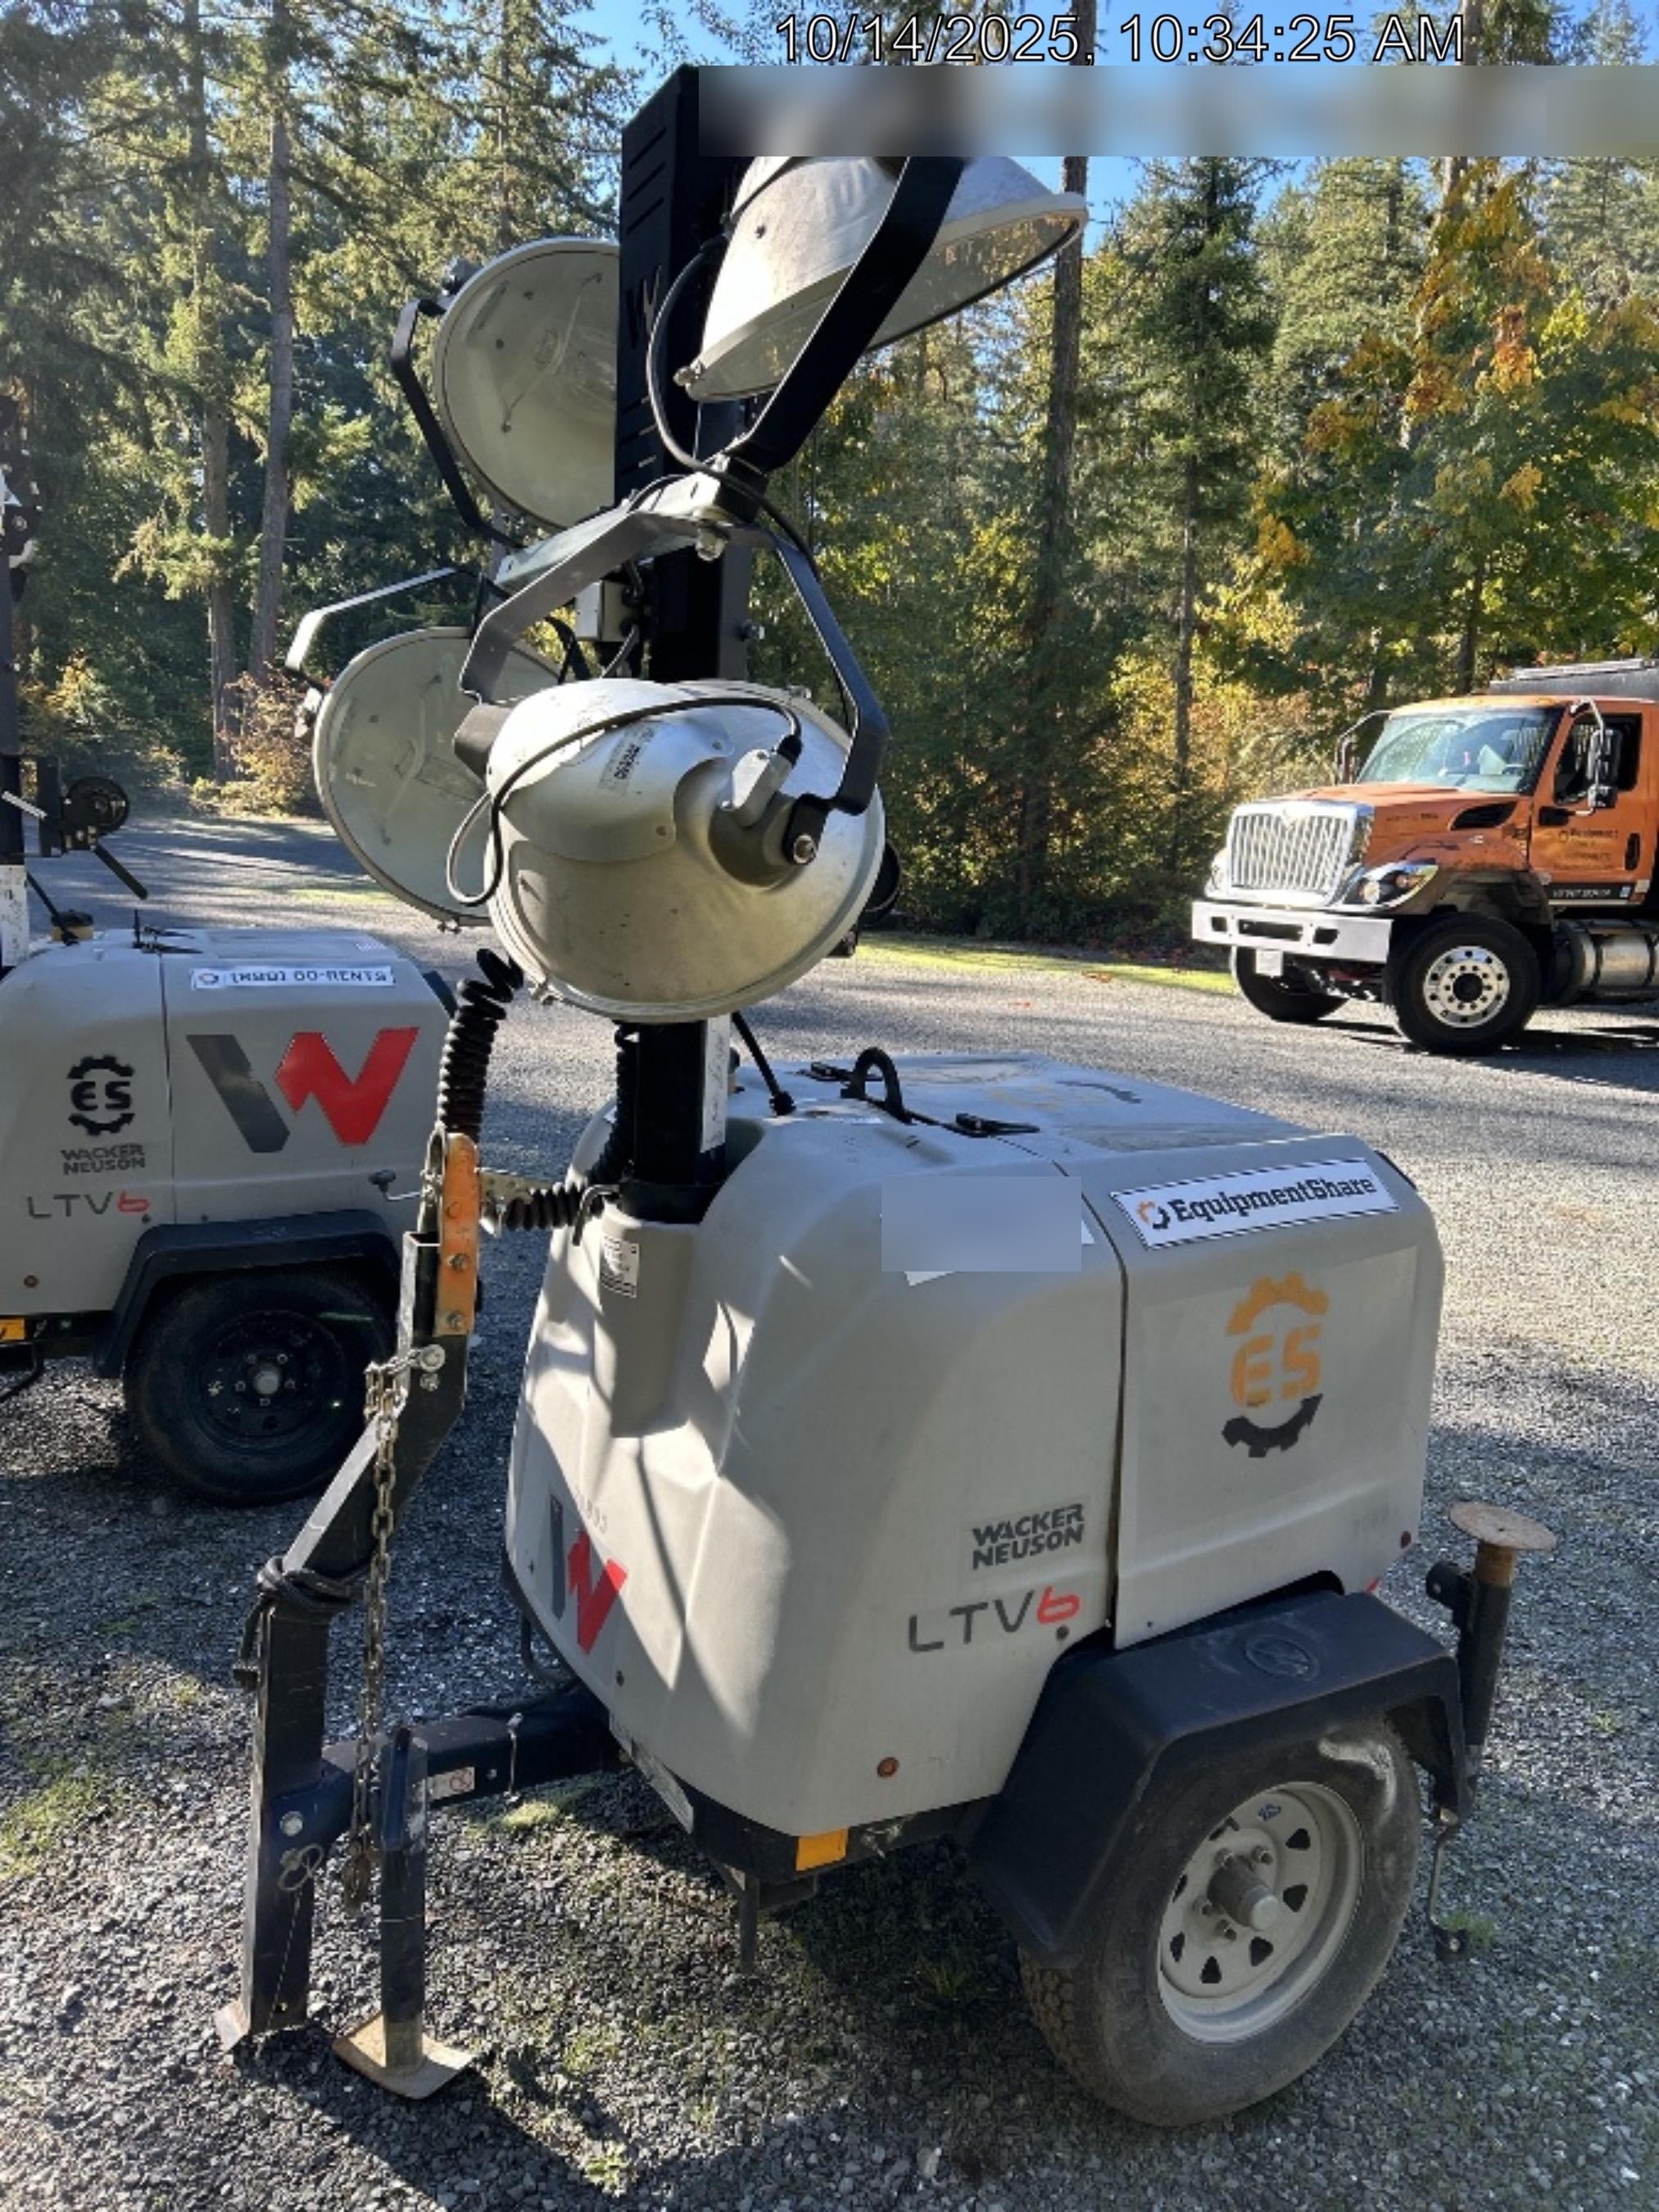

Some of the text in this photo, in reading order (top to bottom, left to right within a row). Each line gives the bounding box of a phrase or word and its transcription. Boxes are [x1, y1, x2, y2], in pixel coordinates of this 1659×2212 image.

[70, 1081, 133, 1112] ES
[61, 1143, 145, 1162] WACKER
[62, 1157, 146, 1176] NEUSON
[1167, 1176, 1377, 1222] EquipmentShare
[1231, 1322, 1322, 1409] ES
[972, 1503, 1085, 1547] WACKER
[972, 1524, 1085, 1571] NEUSON
